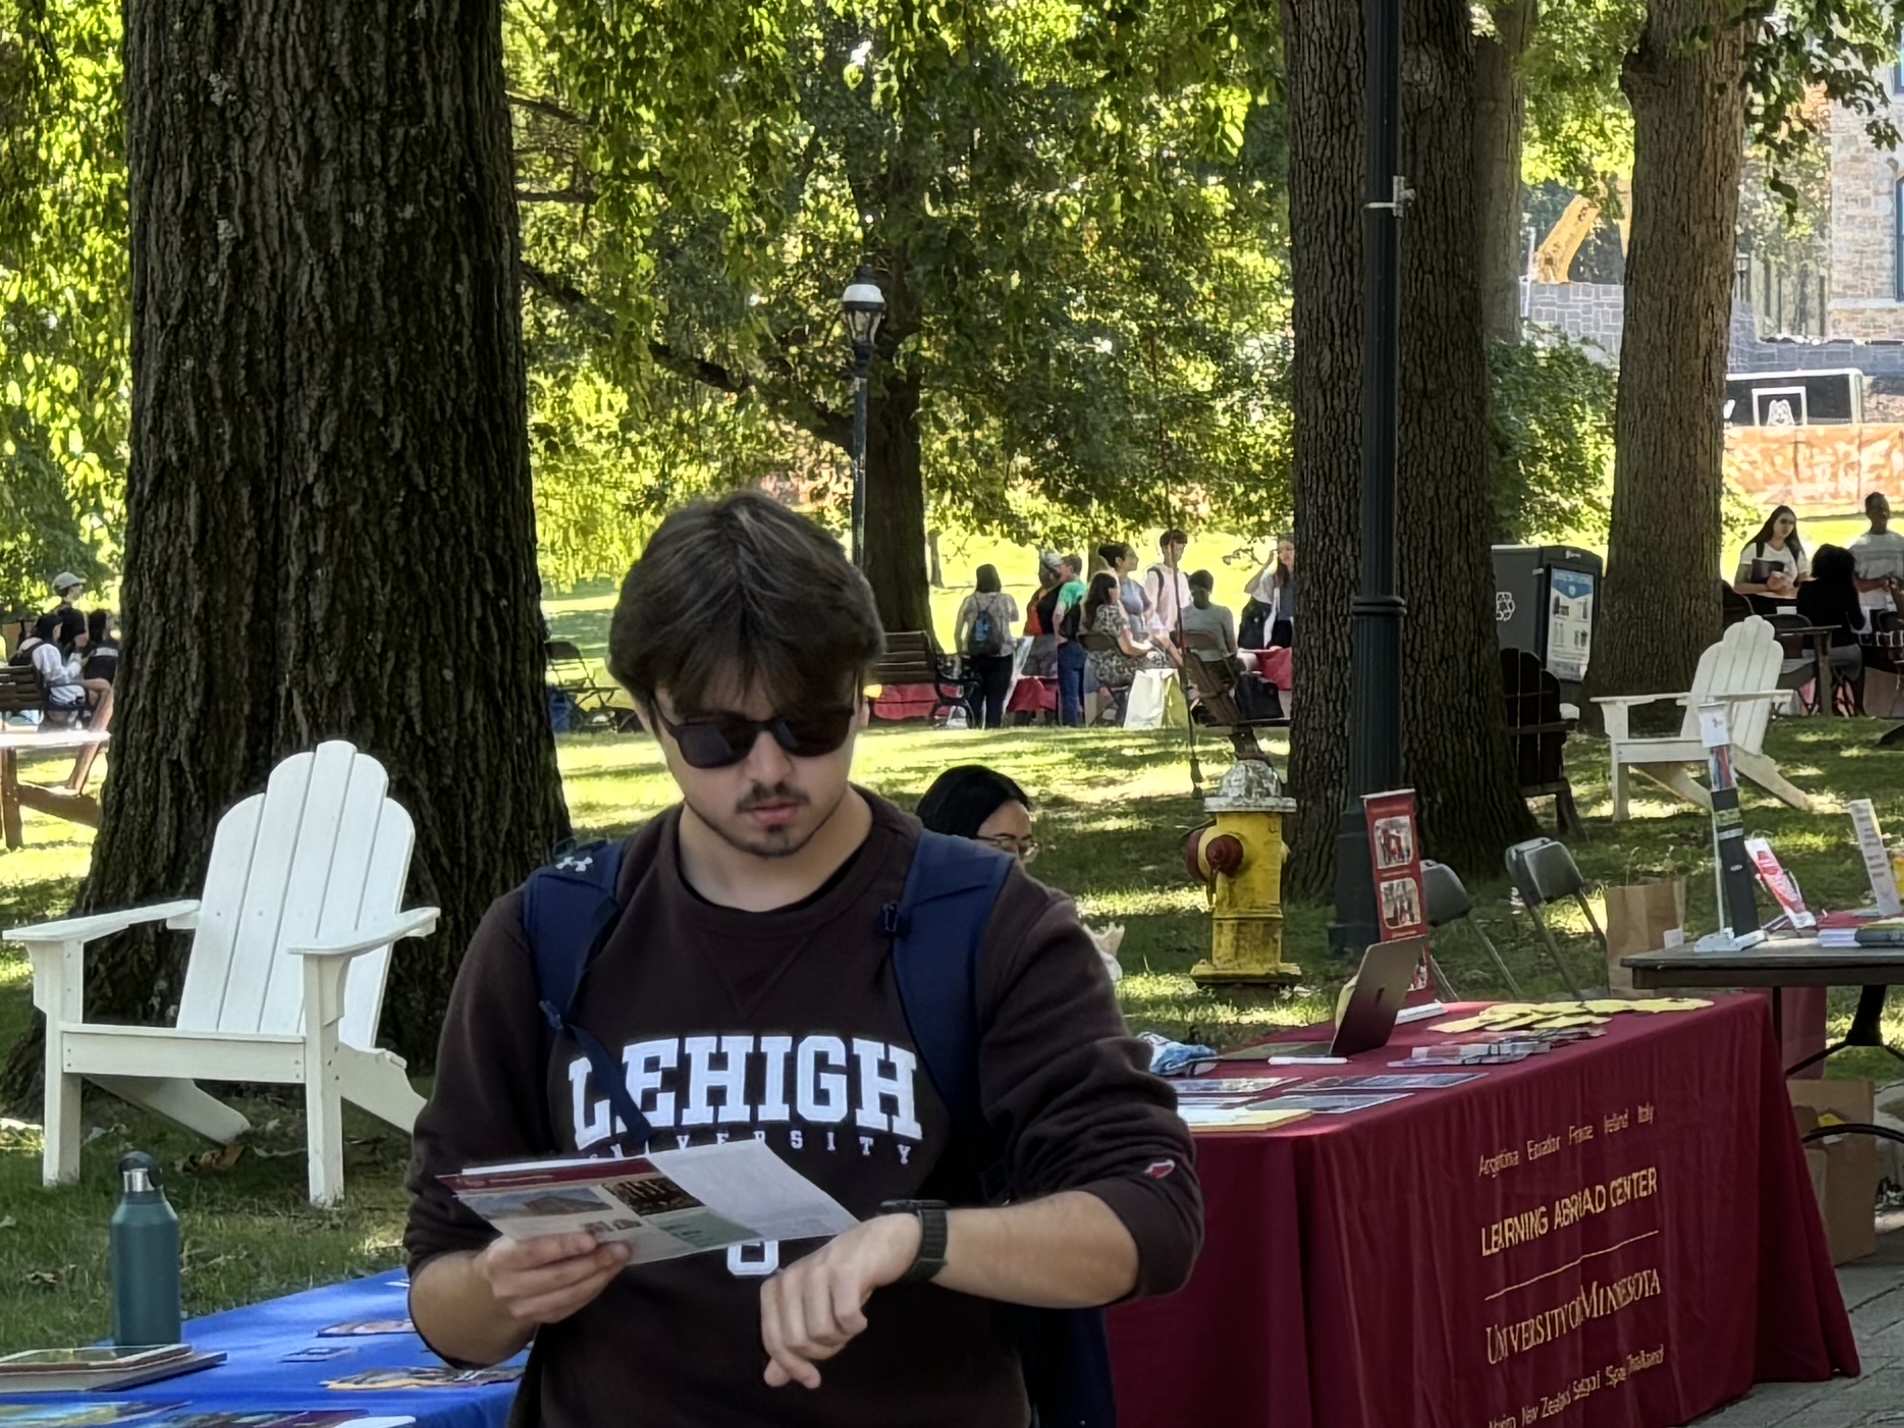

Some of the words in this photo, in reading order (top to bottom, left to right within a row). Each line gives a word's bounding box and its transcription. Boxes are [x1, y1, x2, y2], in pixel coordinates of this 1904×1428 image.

[568, 1034, 923, 1151] LEHIGH
[588, 1129, 912, 1165] NVERSITY
[1481, 1205, 1549, 1257] LEARNING
[1554, 1184, 1607, 1230] ABRAD
[1609, 1166, 1658, 1208] CENTER
